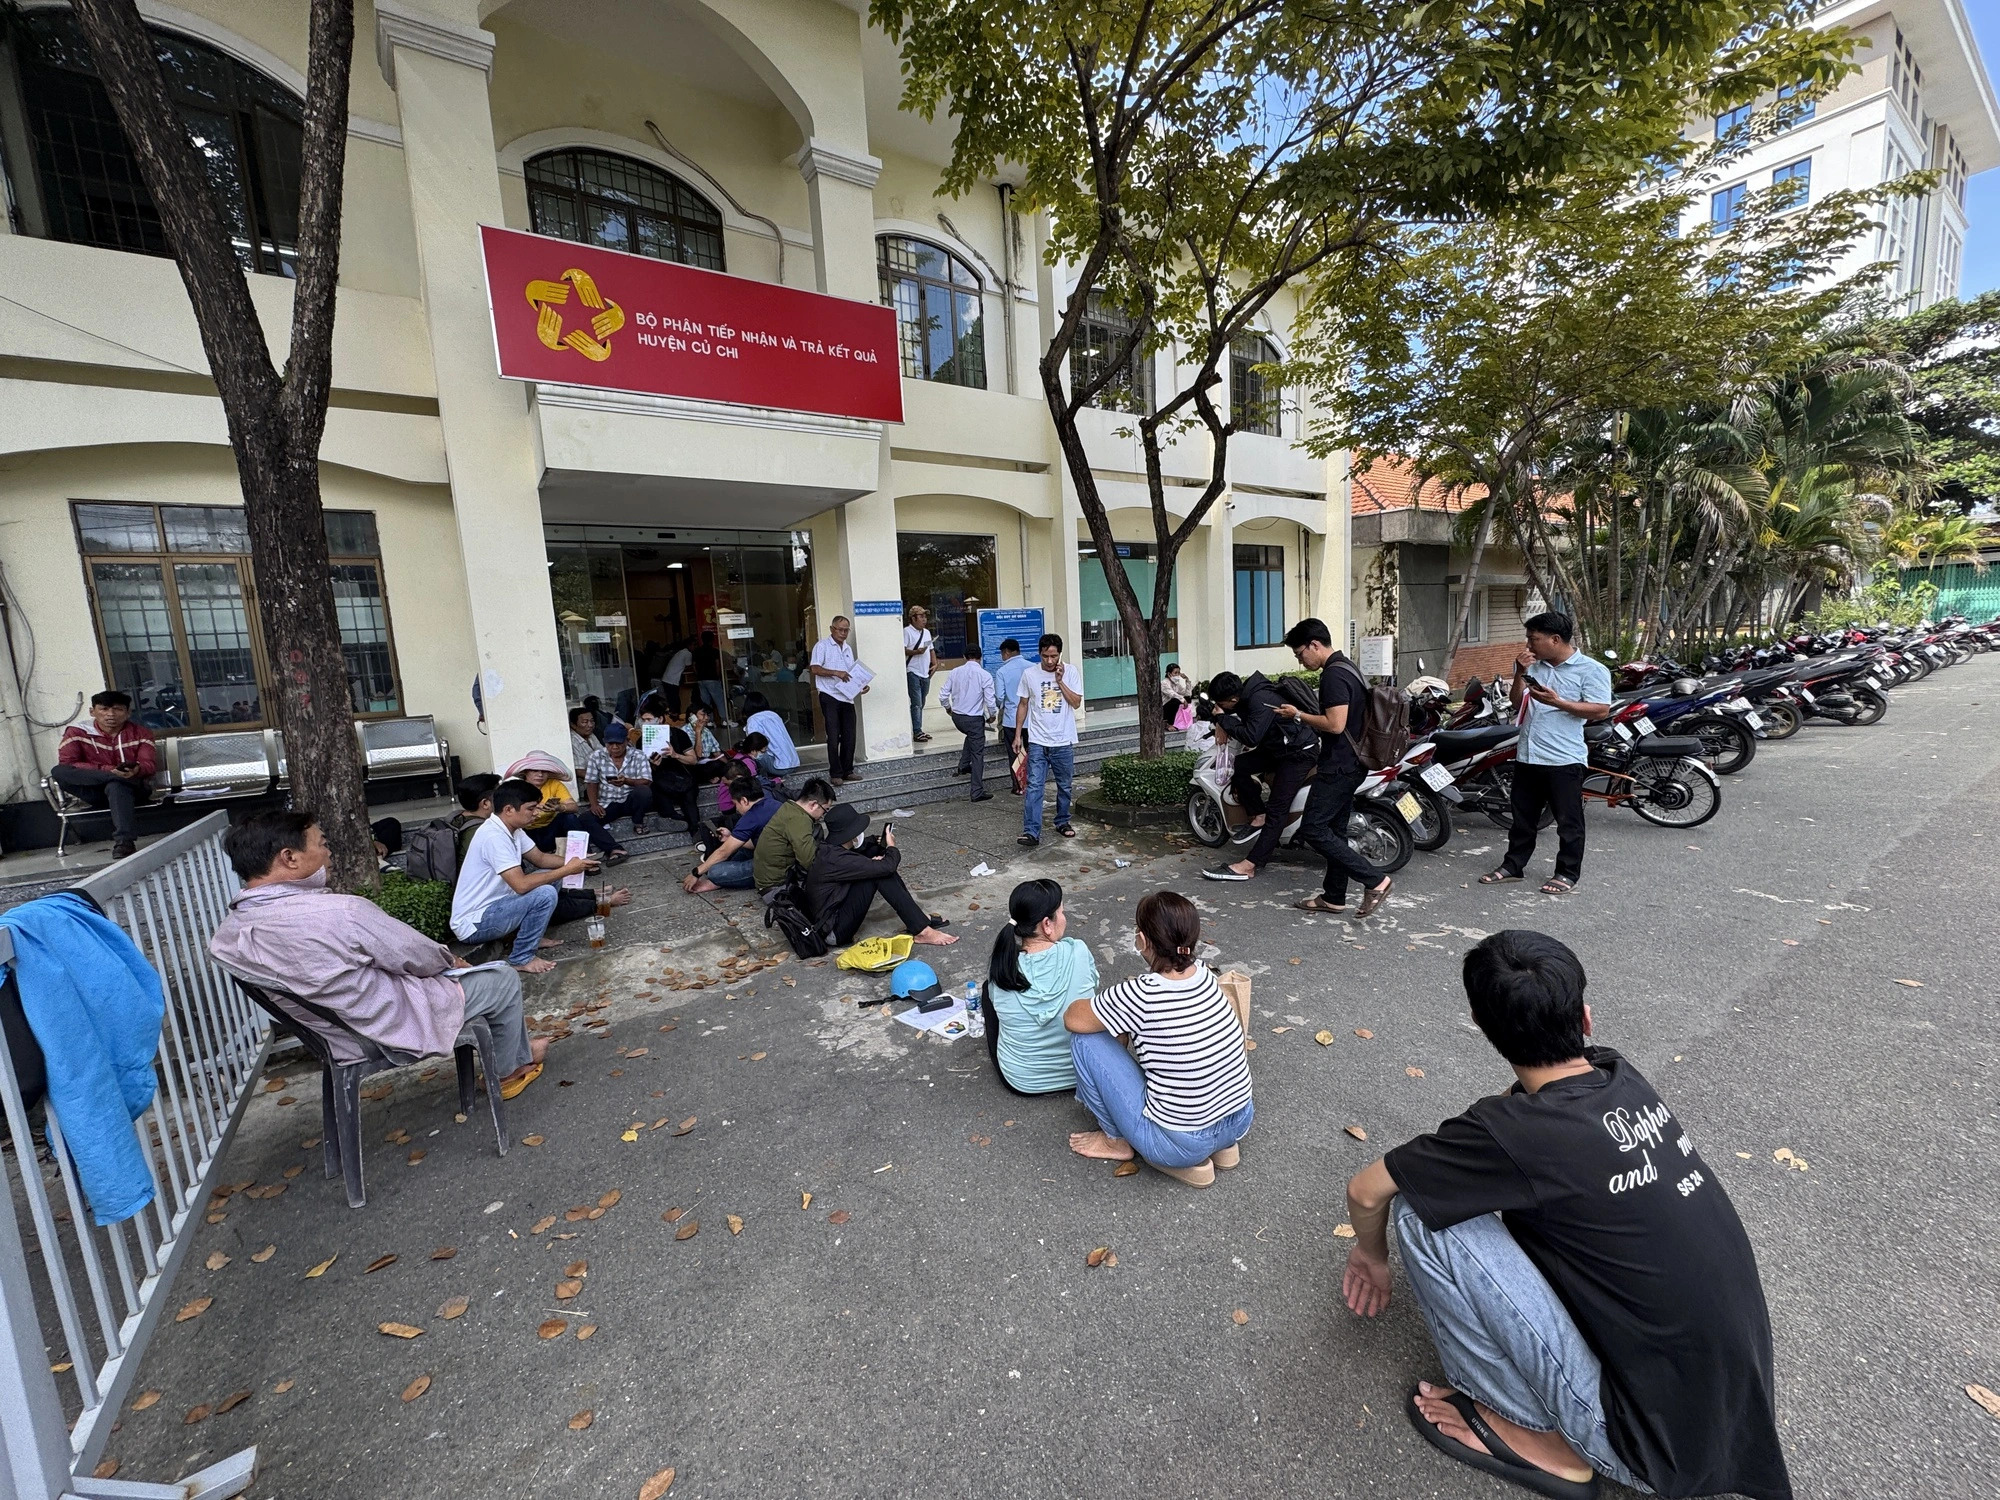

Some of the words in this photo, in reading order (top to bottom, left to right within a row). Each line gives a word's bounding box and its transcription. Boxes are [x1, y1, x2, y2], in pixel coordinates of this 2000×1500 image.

[636, 312, 658, 329] BỘ
[663, 318, 703, 335] PHẬN
[707, 323, 736, 339] TIẾP
[741, 330, 778, 347] NHẬN
[781, 335, 797, 350] VÀ
[800, 340, 824, 355] TRẢ
[828, 343, 850, 358] KẾT
[853, 349, 878, 363] QUẢ
[637, 333, 686, 352] HUYỆN
[691, 339, 711, 355] CỦ
[716, 345, 739, 359] CHI
[1609, 1149, 1658, 1194] and
[1677, 1178, 1695, 1196] S/S
[1690, 1170, 1704, 1187] 24
